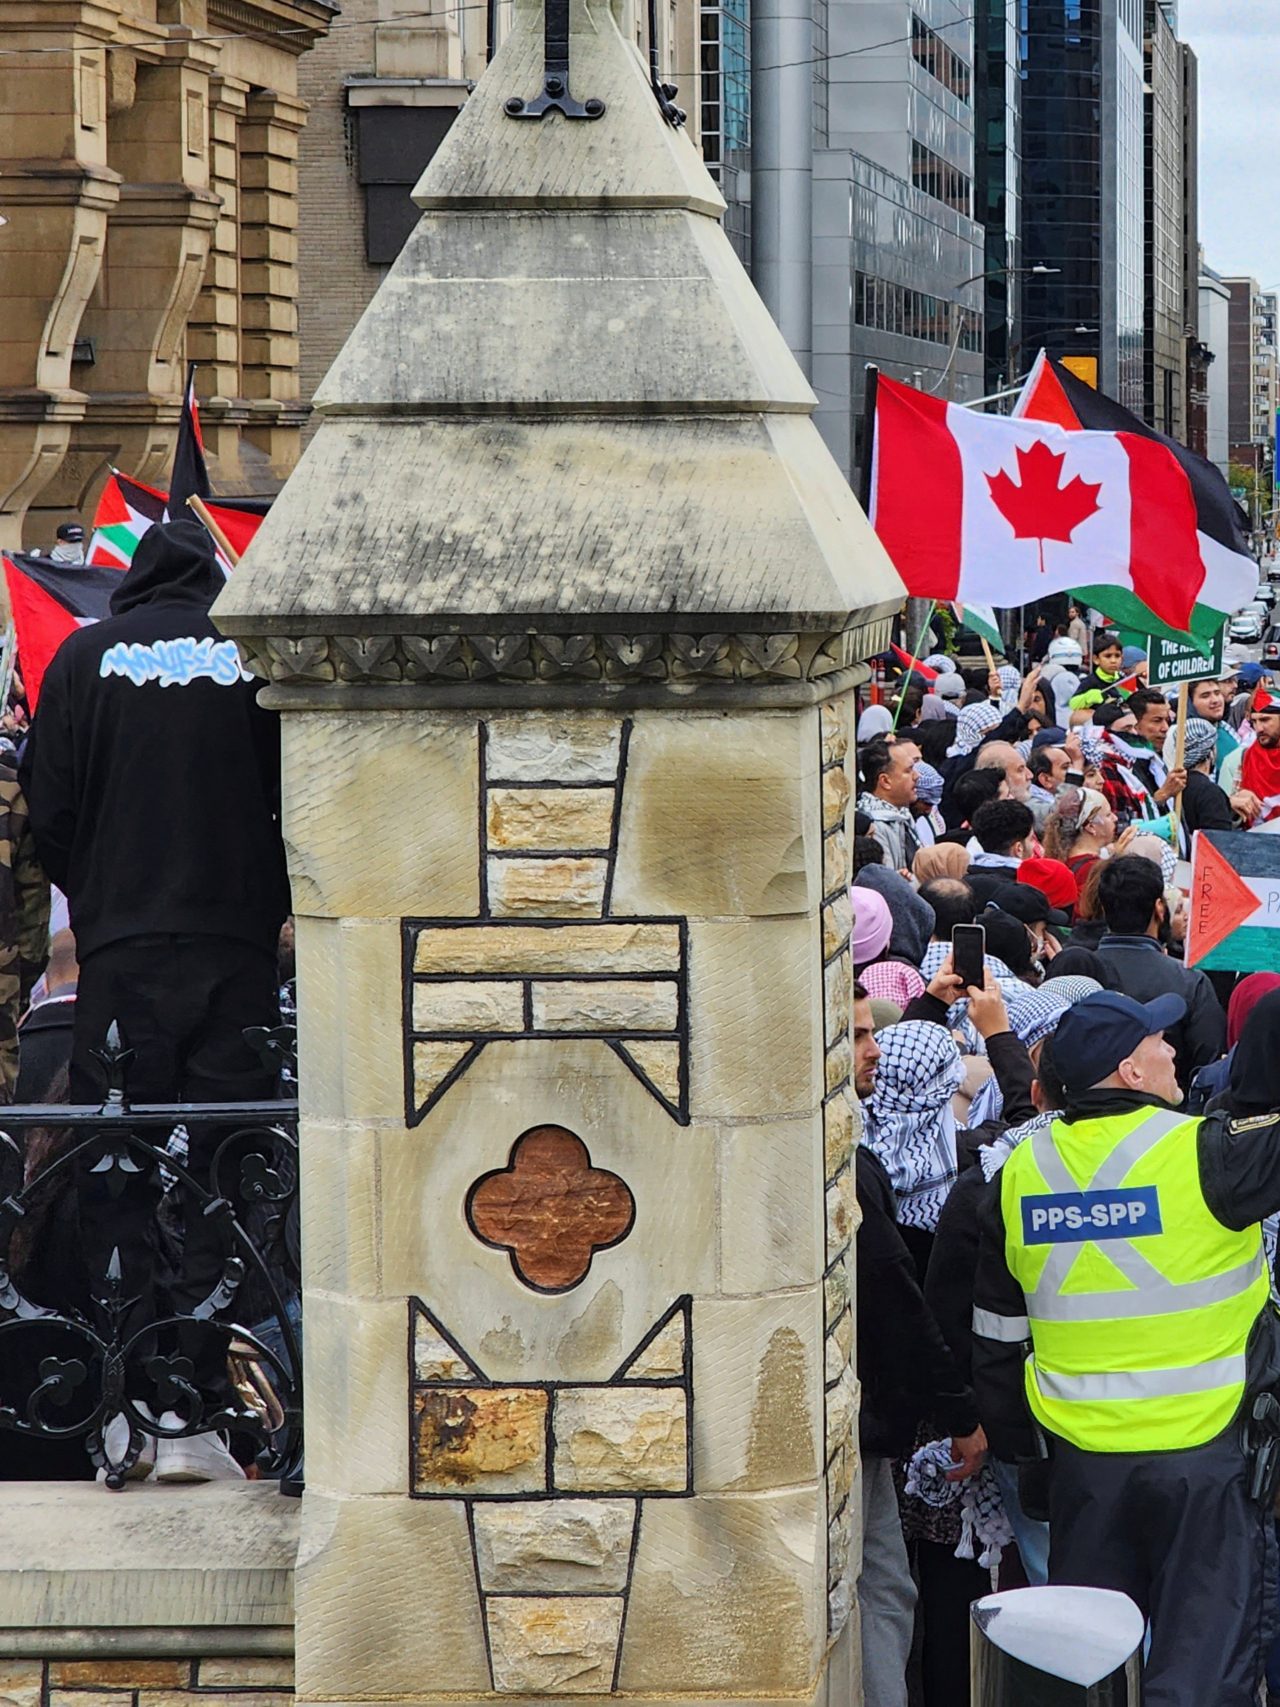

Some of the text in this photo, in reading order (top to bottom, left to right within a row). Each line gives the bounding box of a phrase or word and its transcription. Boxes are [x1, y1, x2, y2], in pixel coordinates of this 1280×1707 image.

[1161, 640, 1179, 656] THE
[1158, 662, 1171, 679] OF
[1198, 865, 1213, 934] FREE
[1031, 1201, 1147, 1231] PPS-SPP
